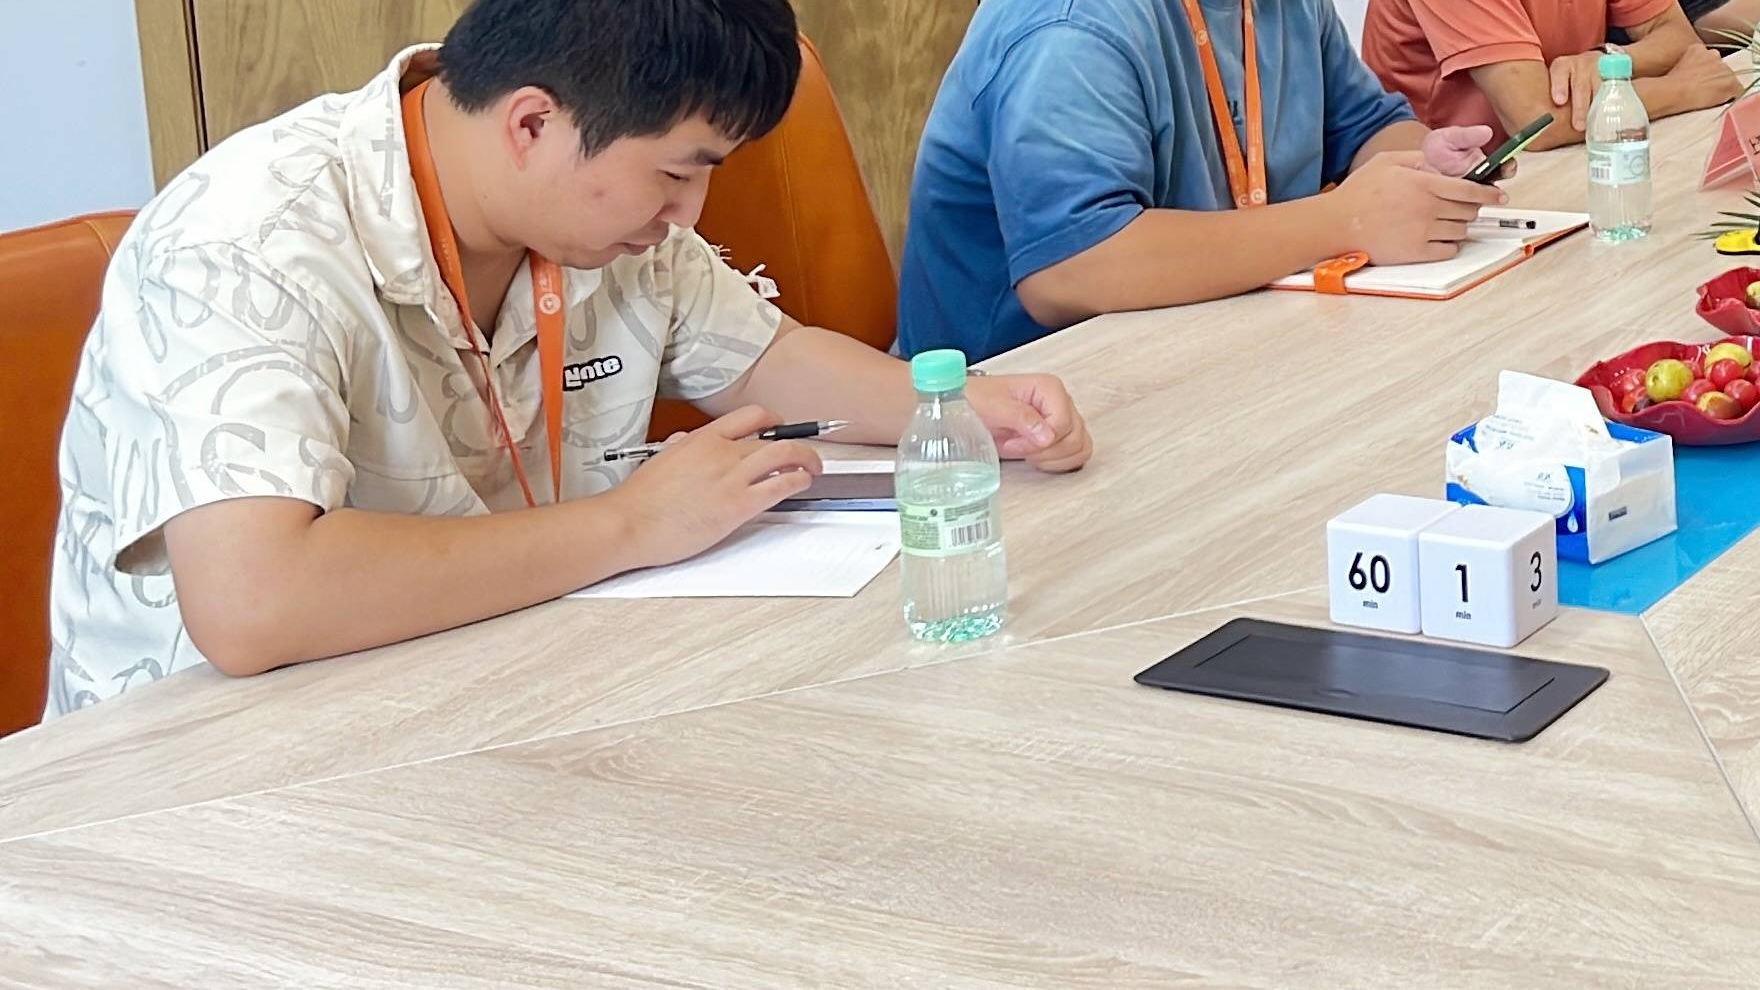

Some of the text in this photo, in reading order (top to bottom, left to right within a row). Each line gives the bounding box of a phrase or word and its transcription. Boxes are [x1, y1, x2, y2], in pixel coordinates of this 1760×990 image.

[1349, 552, 1391, 594] 60
[1455, 563, 1469, 603] 1
[1529, 551, 1542, 592] 3
[1455, 610, 1472, 620] min
